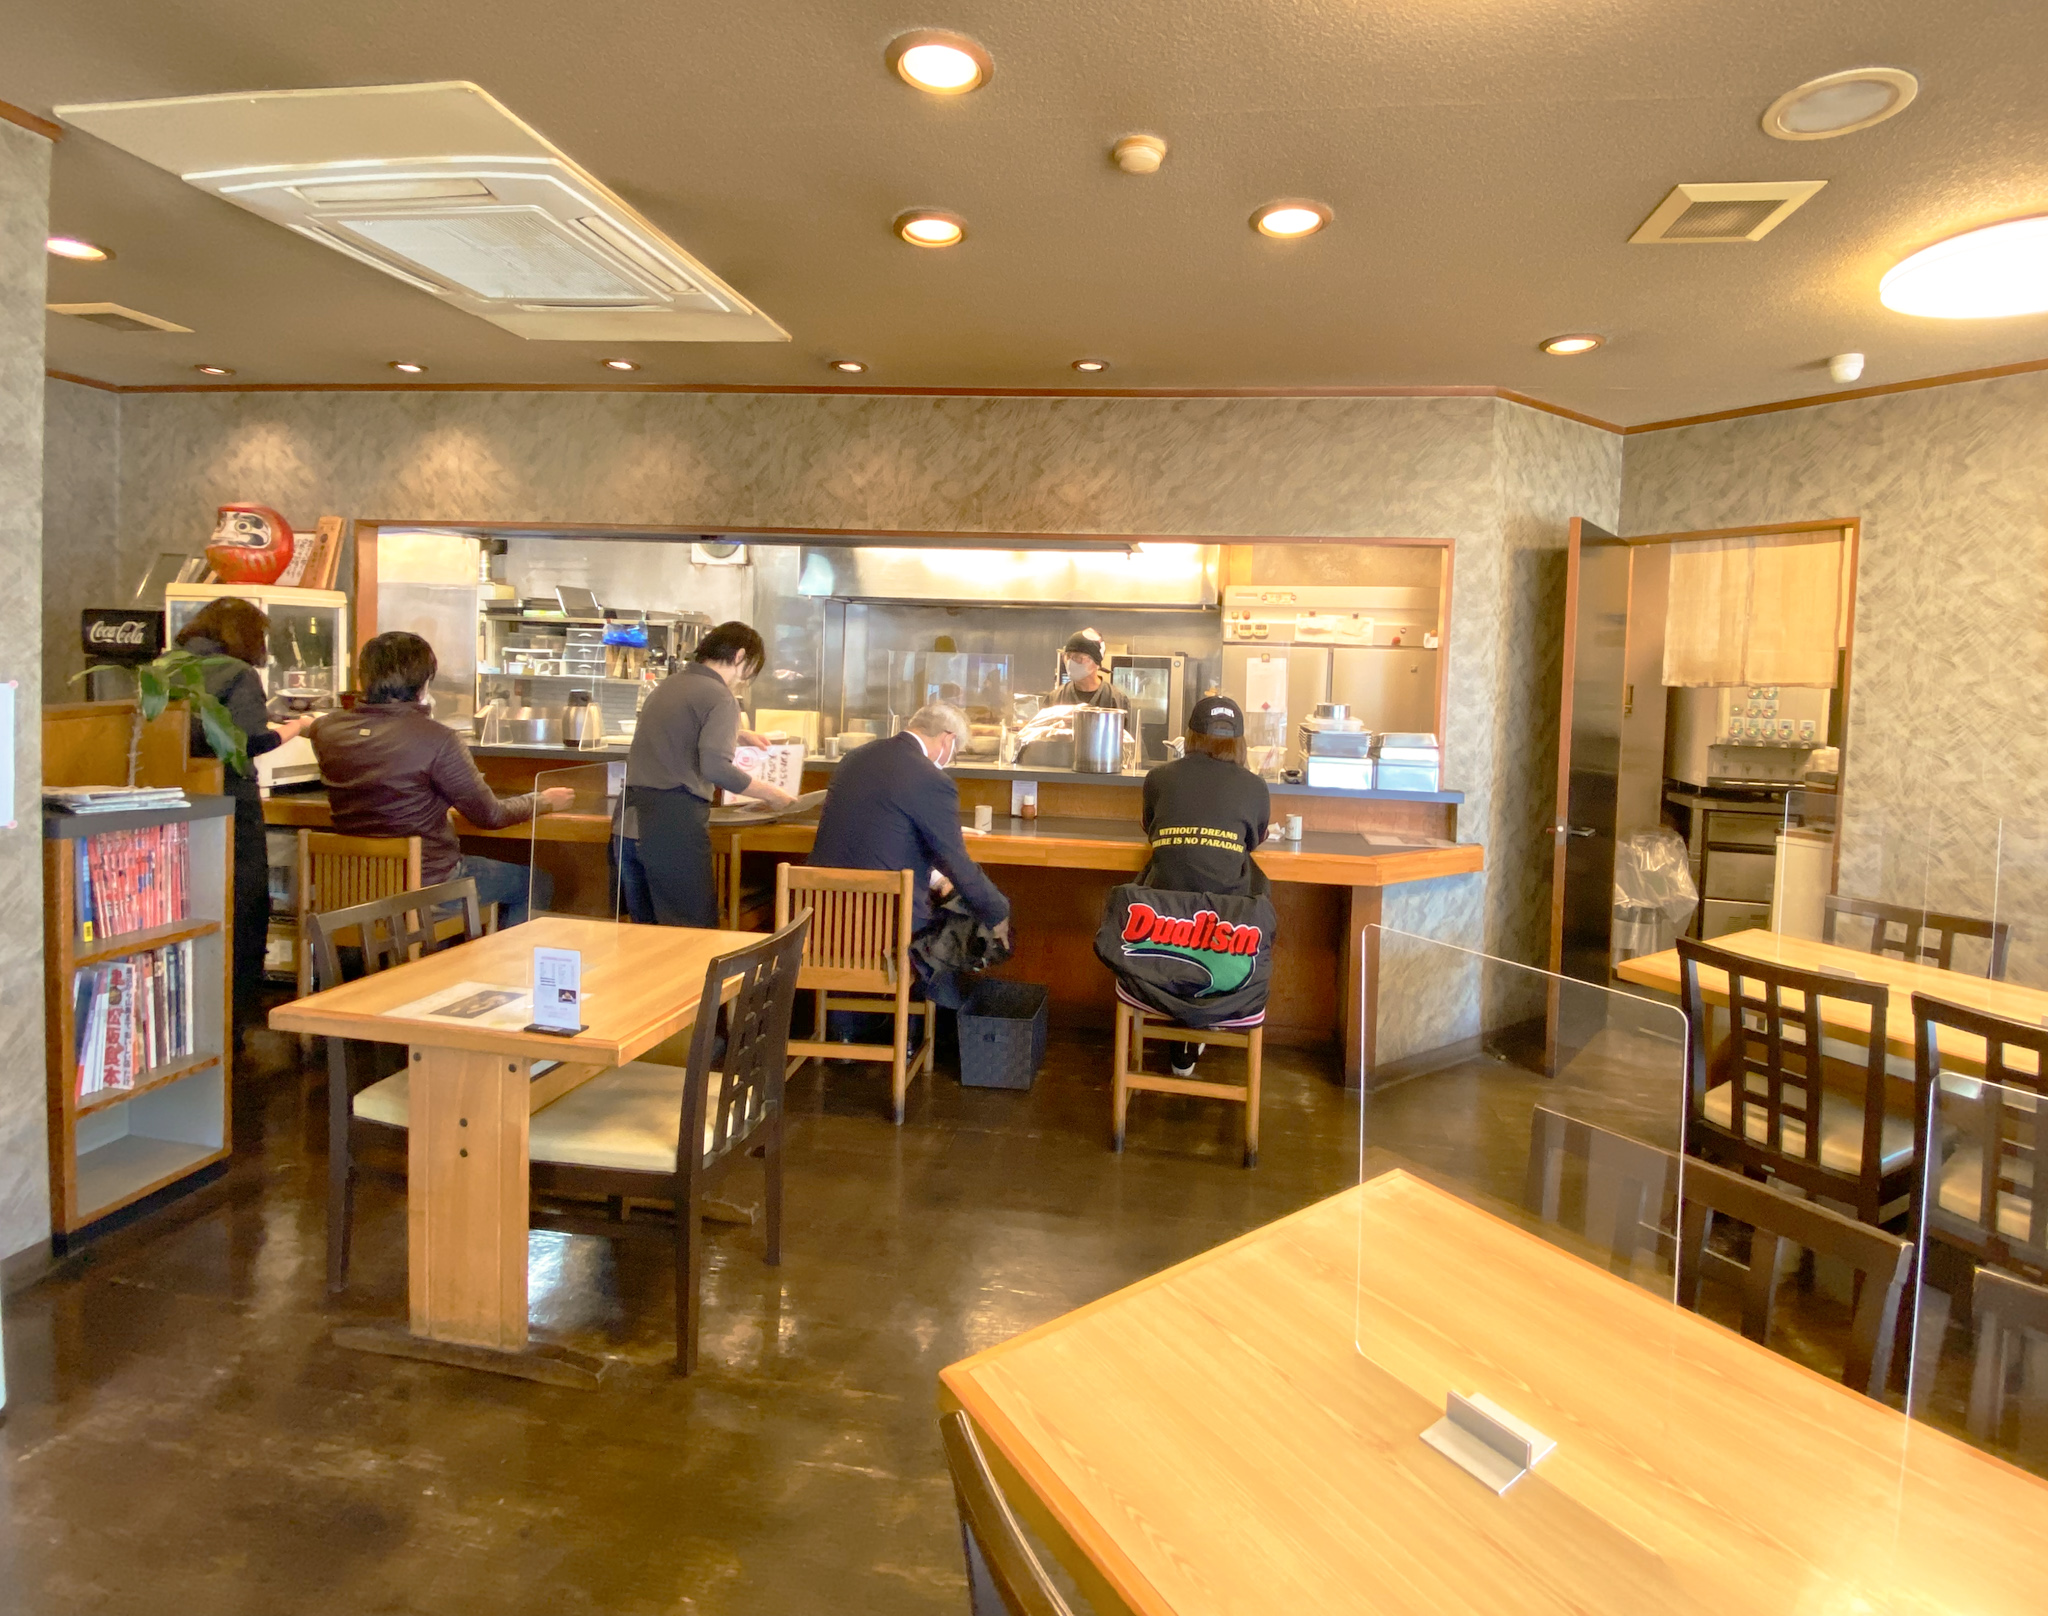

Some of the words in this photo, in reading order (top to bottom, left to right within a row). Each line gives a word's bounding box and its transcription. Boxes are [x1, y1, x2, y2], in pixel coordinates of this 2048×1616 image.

[1159, 826, 1199, 836] WITHOUT
[1200, 827, 1238, 841] DREAMS
[1173, 837, 1182, 845] IS
[1184, 837, 1199, 845] NO
[1122, 902, 1262, 956] Dualism
